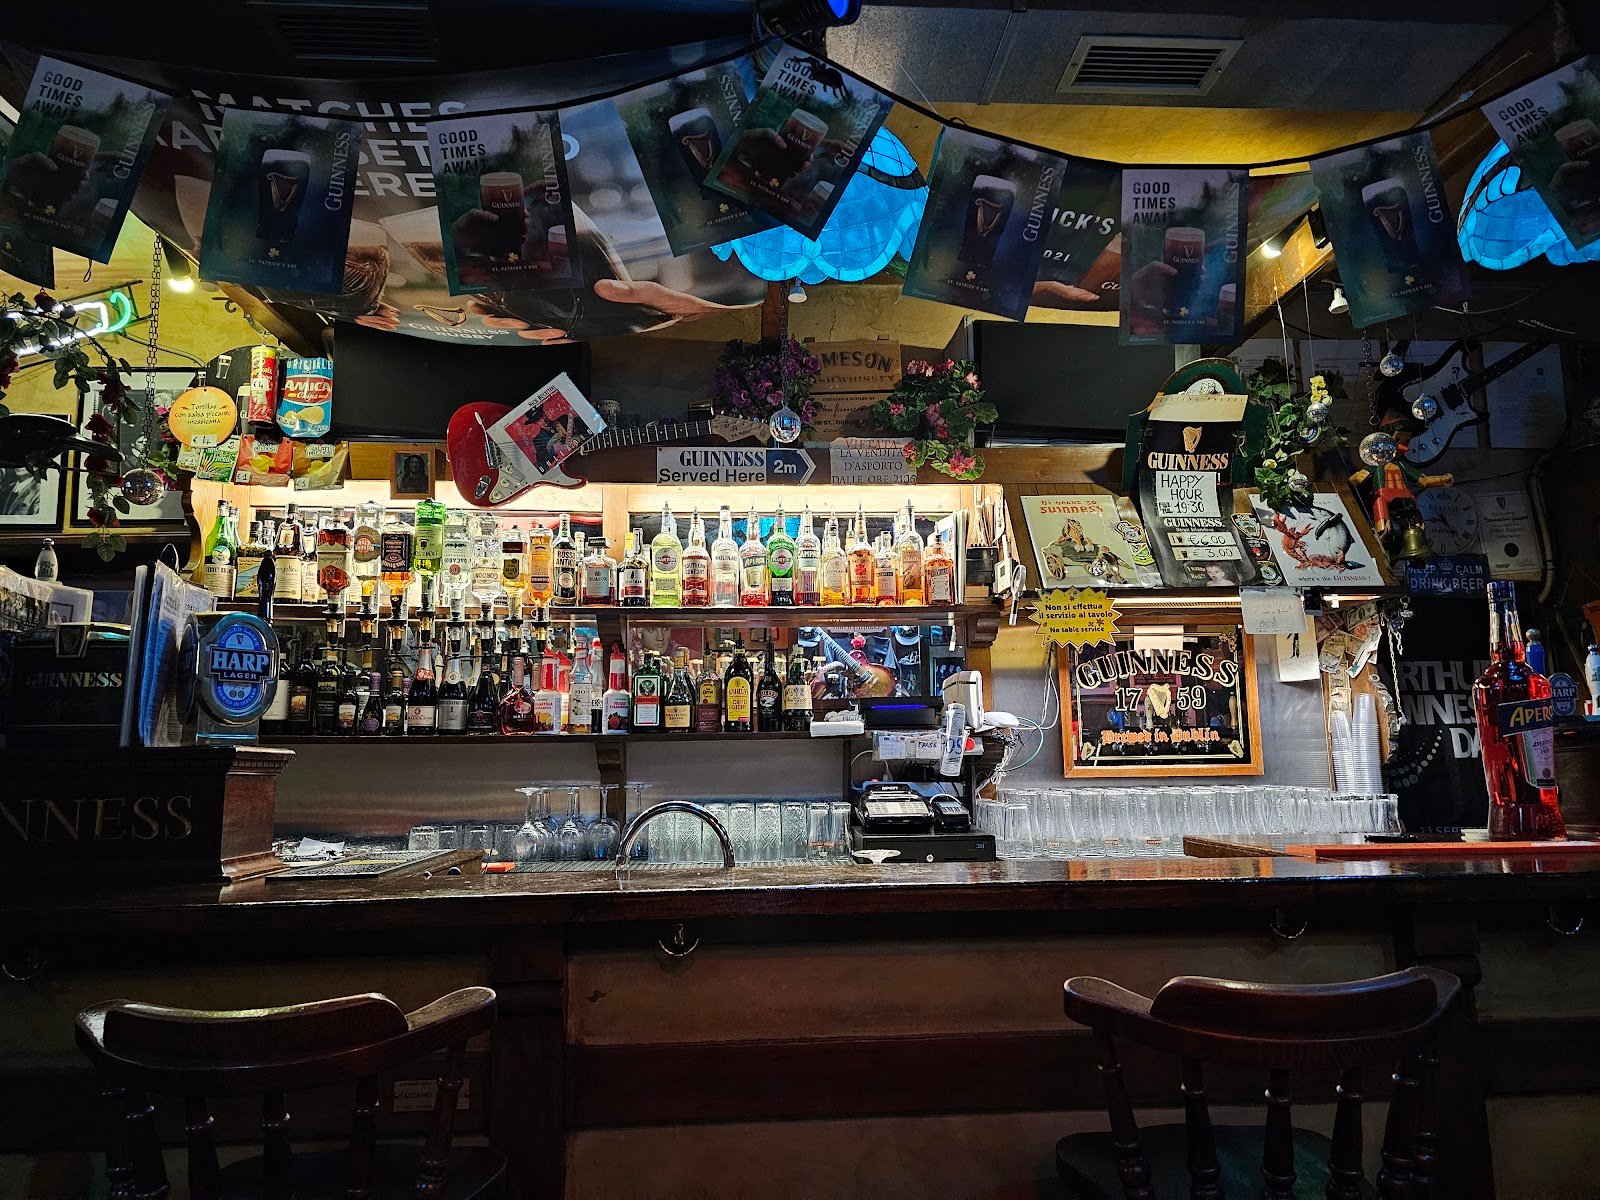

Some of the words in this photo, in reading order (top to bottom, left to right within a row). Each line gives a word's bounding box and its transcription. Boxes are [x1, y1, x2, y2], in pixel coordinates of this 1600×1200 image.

[44, 71, 83, 91] GOOD
[778, 70, 817, 95] TIMES
[38, 85, 84, 107] TIMES
[718, 74, 742, 127] NNESS
[770, 81, 809, 105] AWAIT
[32, 100, 79, 119] AWAIT
[1498, 97, 1535, 122] GOOD
[1505, 106, 1549, 133] TIMES
[439, 130, 478, 144] GOOD
[441, 144, 486, 159] TIMES
[324, 132, 350, 212] GUINNESS
[443, 157, 489, 175] AWAIT
[1133, 182, 1170, 194] GOOD
[1412, 145, 1444, 224] GUINNESS
[1022, 166, 1055, 243] GUINNESS
[1133, 197, 1176, 209] TIMES
[1133, 212, 1178, 225] AWAIT
[408, 322, 510, 337] GUINNESS
[434, 331, 493, 340] RUGBY
[821, 351, 894, 373] MESON
[285, 379, 332, 392] AMICA
[296, 391, 318, 402] Chips
[191, 402, 217, 410] Tortillas
[206, 410, 232, 418] piccante
[679, 450, 765, 468] GUINNESS
[840, 449, 852, 458] LA
[857, 448, 904, 457] VENDITA
[773, 459, 797, 474] 2m
[844, 462, 903, 471] D'ASPORTO
[1147, 451, 1229, 471] GUINNESS
[660, 469, 720, 483] Served
[725, 469, 765, 483] Here
[832, 475, 863, 484] DALLE
[867, 475, 889, 483] ORE
[1161, 474, 1205, 489] HAPPY
[1170, 488, 1203, 501] HOUR
[1174, 500, 1205, 514] 19:30
[1163, 518, 1226, 528] GUINNESS.
[1187, 534, 1226, 545] €6.00
[1455, 565, 1484, 575] CALM
[1410, 577, 1447, 590] DRINK
[1453, 577, 1484, 590] BEER
[1088, 610, 1113, 618] tavolo
[220, 625, 243, 644] COOLED
[212, 650, 270, 673] HARP
[1076, 648, 1239, 689] GUINNESS
[223, 672, 257, 680] LAGER
[1399, 660, 1488, 692] RTHU
[239, 687, 258, 707] IRELAND
[1114, 687, 1143, 712] 17
[1176, 685, 1207, 711] 59
[1552, 688, 1576, 698] HARP
[1403, 693, 1476, 726] NNE
[1101, 728, 1152, 744] Brewed
[1154, 728, 1169, 743] in
[1171, 727, 1221, 744] Dublin
[0, 795, 194, 841] NNESS
